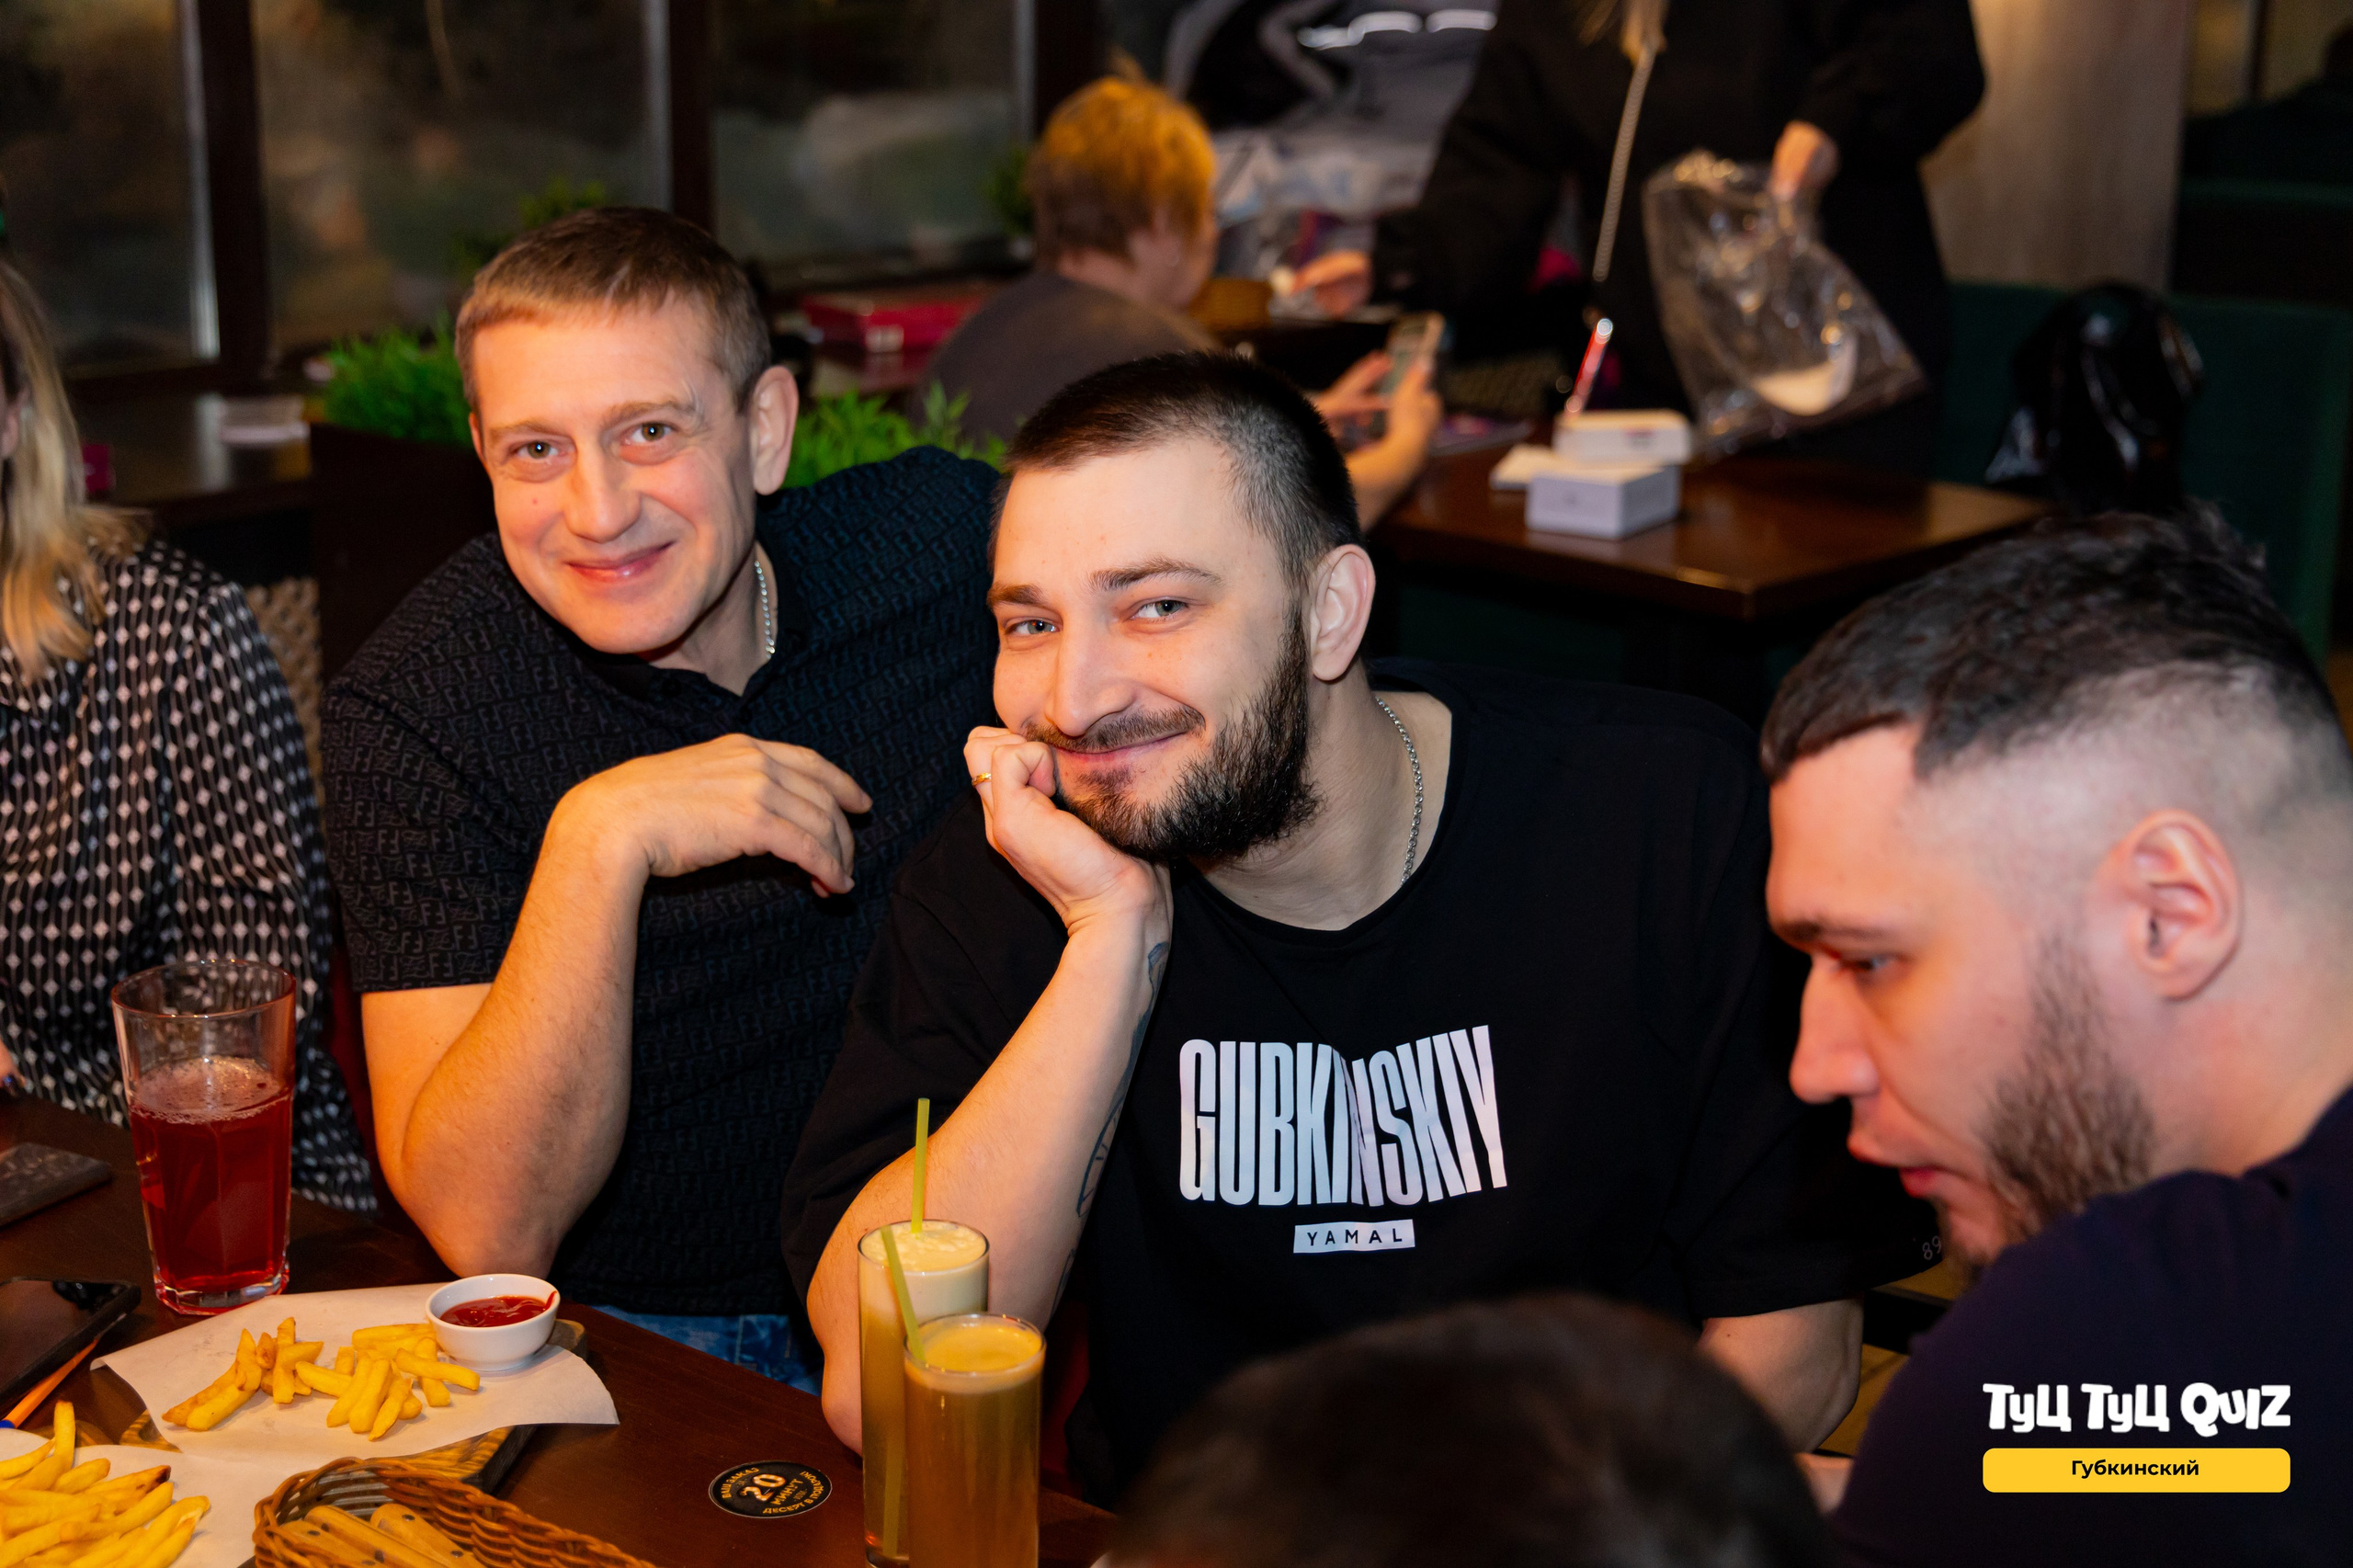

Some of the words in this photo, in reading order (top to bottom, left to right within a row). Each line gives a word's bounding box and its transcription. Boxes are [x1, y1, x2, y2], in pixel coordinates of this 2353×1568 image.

[1179, 1024, 1507, 1207] GUBKINSKIY
[1307, 1227, 1403, 1246] YAMAL
[726, 1467, 760, 1483] ЗАКАЗ
[721, 1483, 733, 1499] ВАШ
[739, 1473, 787, 1501] 20
[770, 1478, 804, 1505] МИНУТ
[762, 1502, 805, 1514] ДЕСЕРТ
